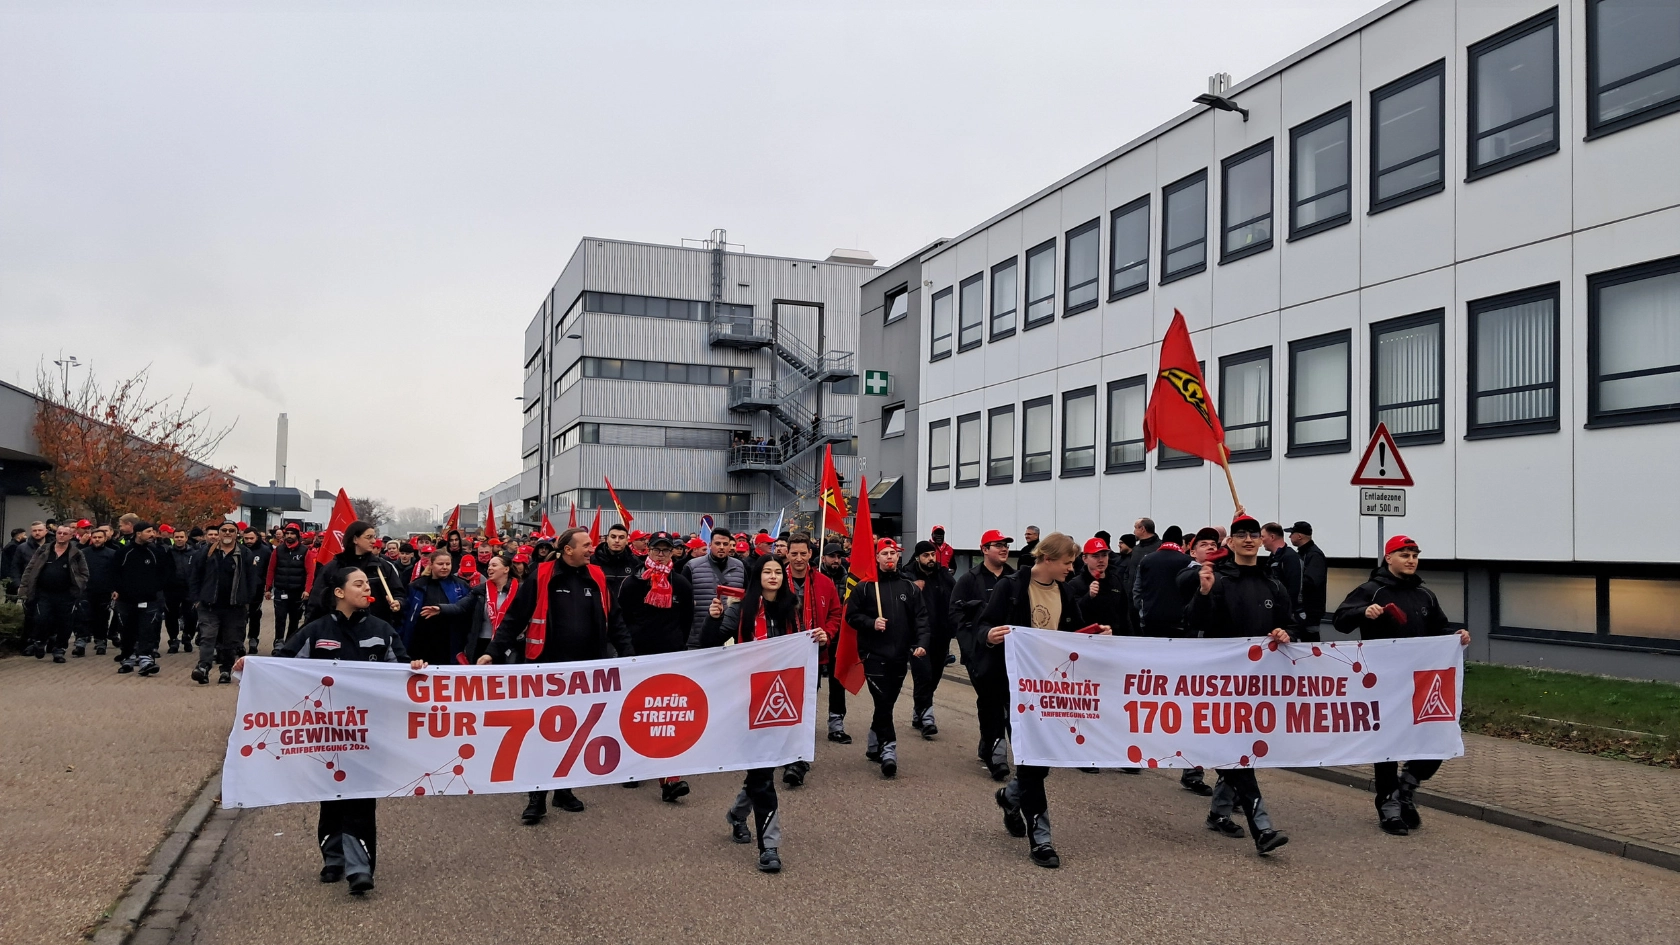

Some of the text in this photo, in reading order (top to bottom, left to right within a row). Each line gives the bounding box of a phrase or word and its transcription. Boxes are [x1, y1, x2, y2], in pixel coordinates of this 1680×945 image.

[1364, 492, 1402, 501] Entladezone
[1366, 503, 1377, 512] auf
[1379, 503, 1392, 512] 500
[406, 667, 622, 703] GEMEINSAM
[1019, 678, 1100, 697] SOLIDARITÄT
[1123, 669, 1349, 697] FÜR AUSZUBILDENDE
[644, 694, 688, 708] DAFÜR
[1040, 695, 1100, 712] GEWINNT
[243, 706, 369, 731] SOLIDARITÄT
[633, 710, 695, 723] STREITEN
[1041, 711, 1085, 719] TARIFBEWEGUNG
[1123, 701, 1381, 734] 170 EURO MEHR!
[280, 727, 369, 746] GEWINNT
[650, 725, 676, 737] WIR
[281, 743, 370, 755] TARIFBEWEGUNG 2024
[408, 702, 621, 783] FÜR 7%
